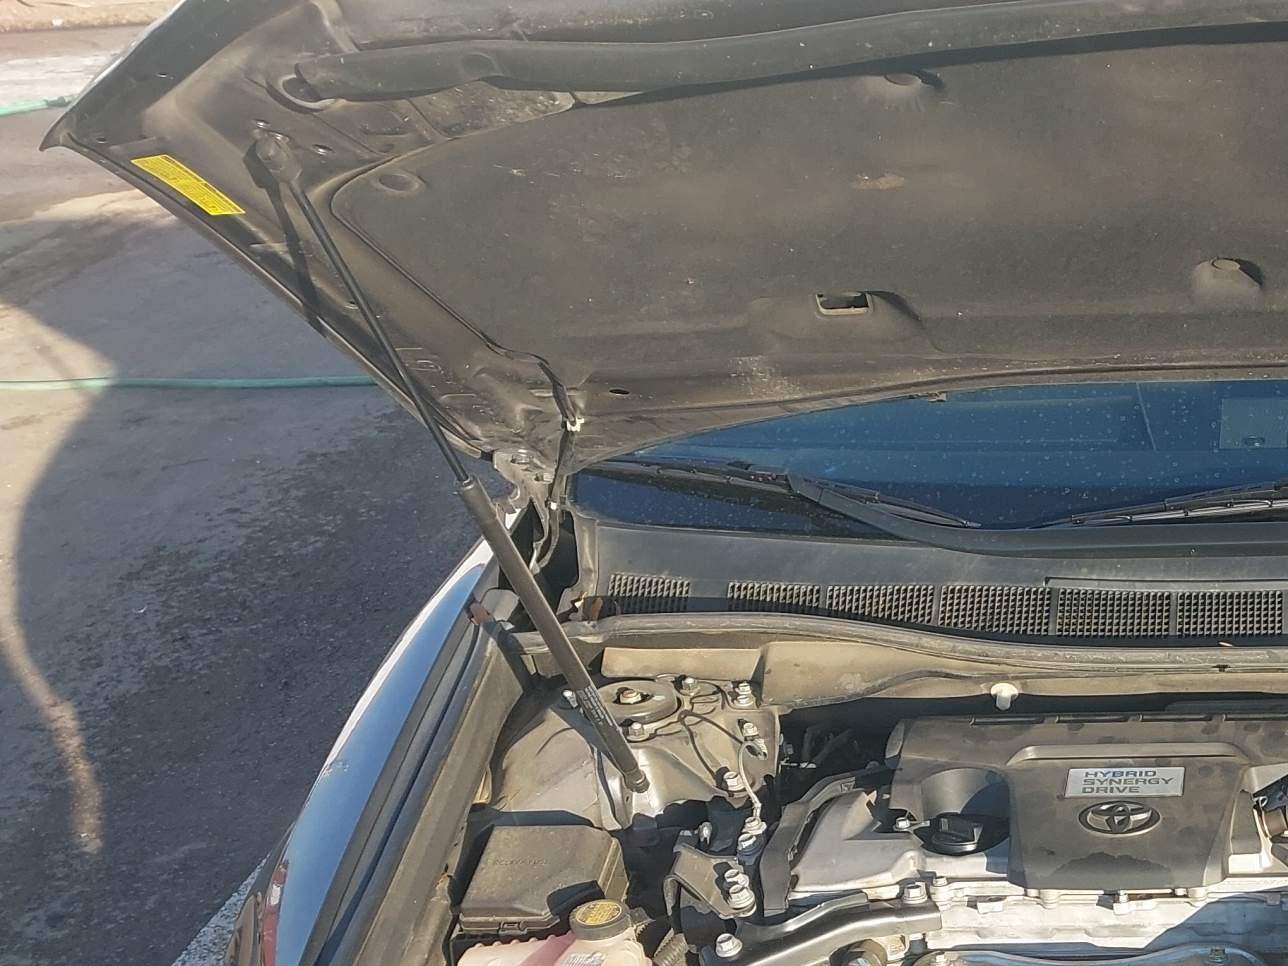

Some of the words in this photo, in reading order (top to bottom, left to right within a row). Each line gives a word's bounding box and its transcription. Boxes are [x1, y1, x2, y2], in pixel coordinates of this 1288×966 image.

[1085, 770, 1157, 778] HYBRID
[1083, 777, 1174, 785] SYNERGY
[1082, 786, 1140, 794] DRIVE
